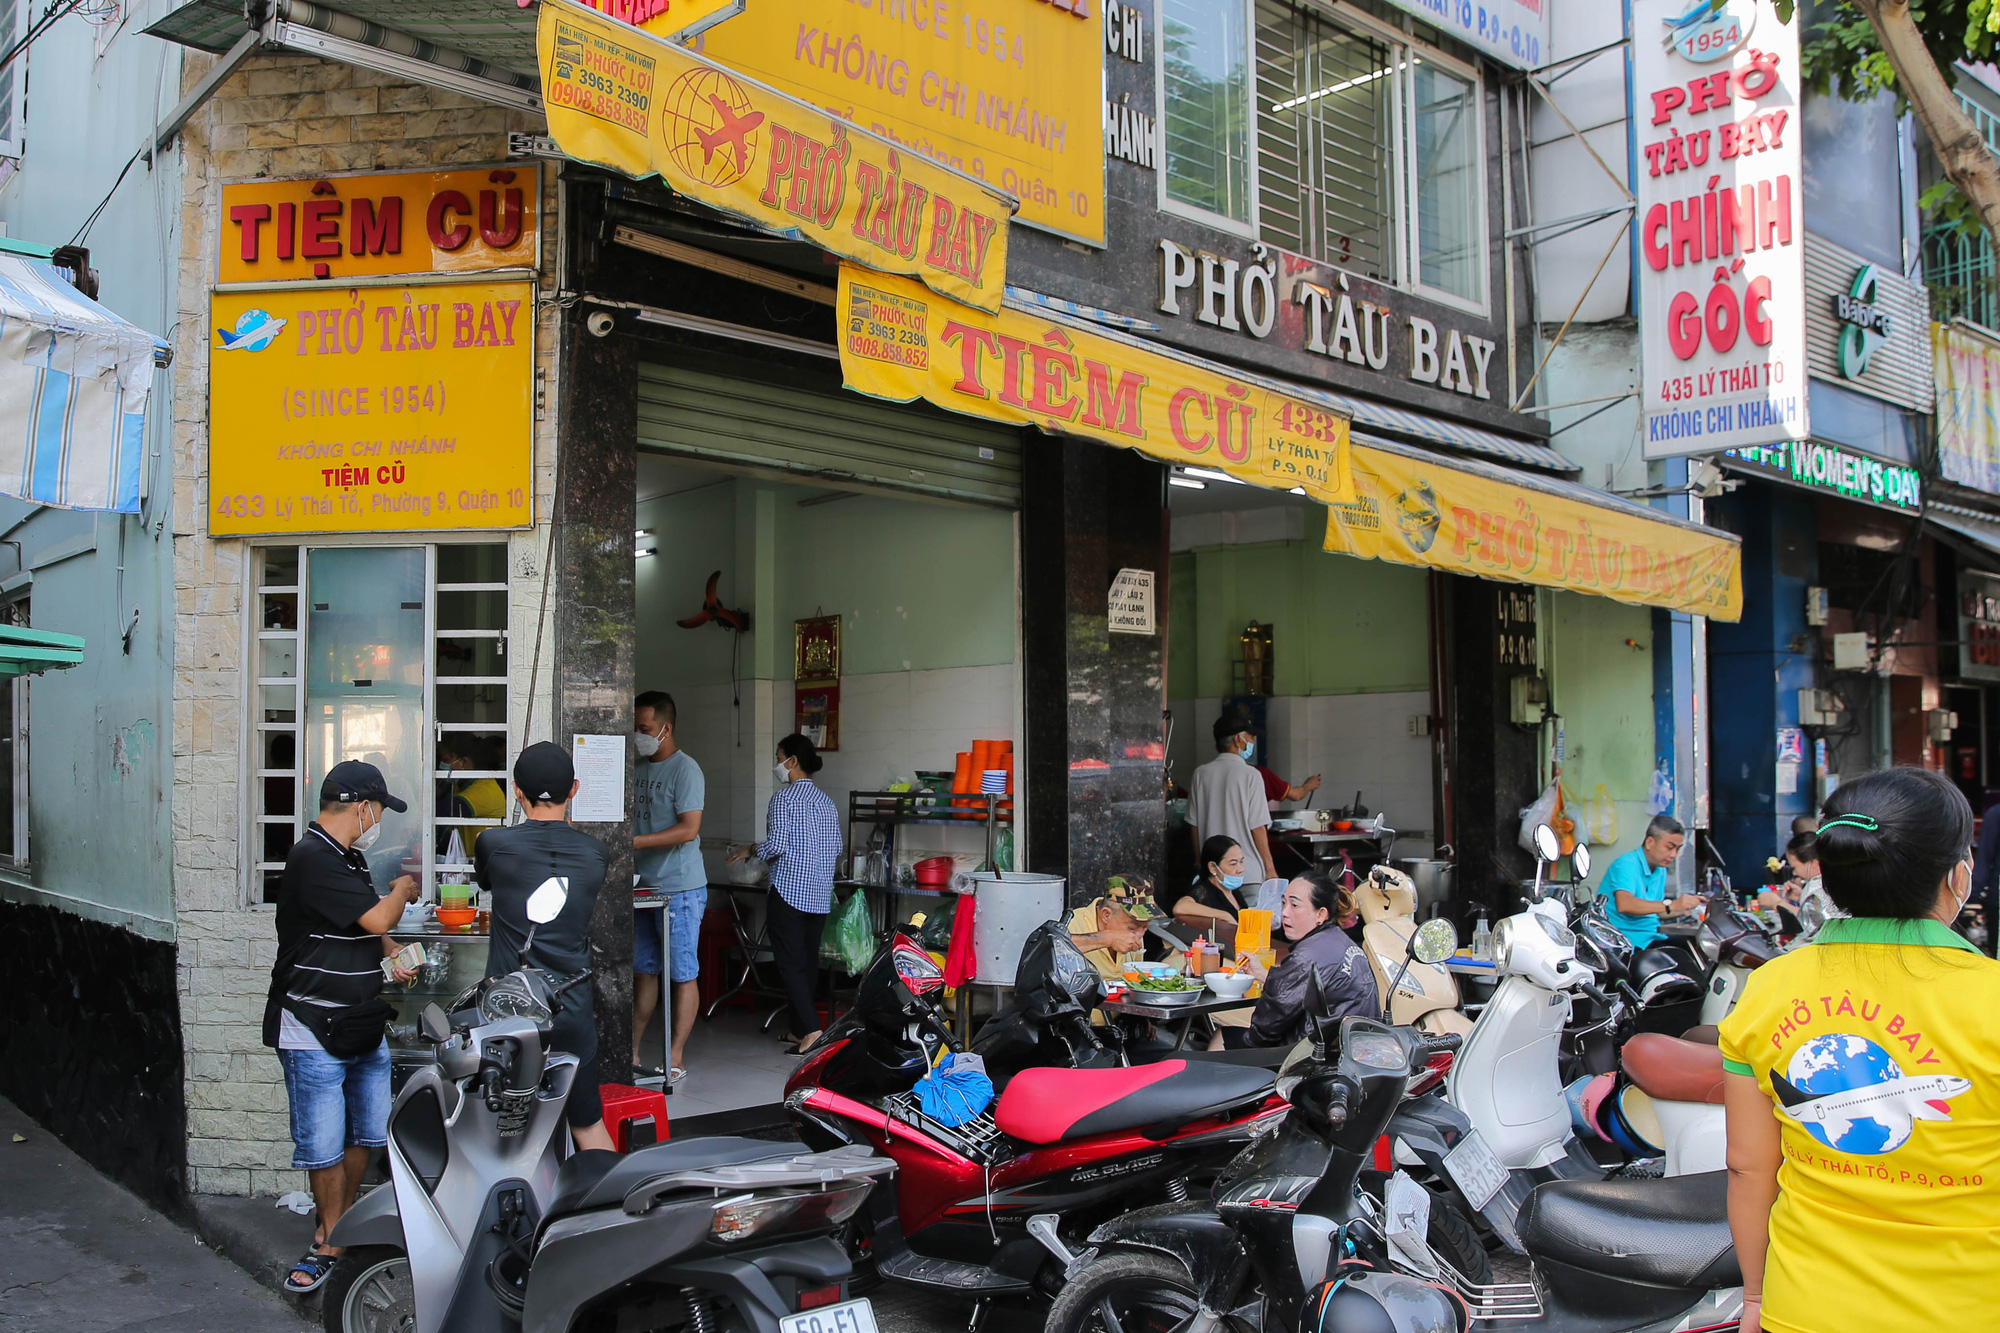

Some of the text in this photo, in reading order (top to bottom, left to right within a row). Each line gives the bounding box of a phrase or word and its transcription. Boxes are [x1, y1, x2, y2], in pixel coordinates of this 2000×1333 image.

[961, 12, 1024, 69] 1954
[1107, 0, 1143, 64] CHI
[1510, 25, 1539, 66] Q.10
[1683, 24, 1739, 56] 1954
[578, 68, 648, 111] 3963 2390
[585, 49, 651, 94] PHƯỚC LỢI
[795, 23, 1067, 154] KHÔNG CHI NHÁNH
[1651, 48, 1780, 126] PHỞ
[551, 81, 647, 133] 0908.858.852
[1107, 92, 1158, 170] HÁNH
[1644, 109, 1788, 177] TÀU BAY
[759, 118, 997, 290] PHỞ TÀU BAY
[1001, 167, 1058, 210] Quận
[1067, 189, 1089, 218] 10
[230, 169, 524, 280] TIỆM CŨ
[1643, 174, 1792, 271] CHÍNH
[296, 288, 522, 356] PHỞ TÀU BAY
[872, 302, 925, 335] PHƯỚC LỢI
[1156, 241, 1496, 400] PHỞ TÀU BAY
[1668, 257, 1773, 360] GỐC
[850, 334, 927, 368] 0908.858.852
[868, 322, 927, 348] 3963 2390
[283, 380, 446, 421] (SINCE 1954)
[939, 318, 1257, 466] TIỆM CŨ
[1661, 376, 1693, 402] 435
[1699, 366, 1715, 397] LÝ
[1720, 361, 1758, 393] THÁI
[1272, 400, 1336, 443] 433
[1650, 392, 1796, 442] KHÔNG CHI NHÁNH
[276, 433, 457, 460] KHÔNG CHI NHÁNH
[1268, 436, 1285, 453] LÝ
[1287, 440, 1320, 461] THÁI
[321, 459, 406, 492] TIỆM CŨ
[1306, 465, 1328, 483] Q.10
[1790, 441, 1884, 502] WOMEN'S
[1884, 466, 1920, 507] DAY
[217, 494, 266, 518] 433
[275, 495, 294, 521] Lý
[300, 493, 333, 516] Thái
[371, 490, 432, 517] Phường
[457, 488, 499, 511] Quận
[506, 487, 524, 507] 10
[1451, 497, 1541, 574] PHỞ
[1545, 519, 1624, 590] TÀU
[1628, 545, 1698, 601] BAY
[635, 779, 662, 791] NEER
[1771, 990, 1941, 1067] PHỞ TÀU BAY
[1797, 1150, 1813, 1166] LÝ
[1819, 1157, 1860, 1175] THÁI
[1939, 1174, 1983, 1187] Q.10
